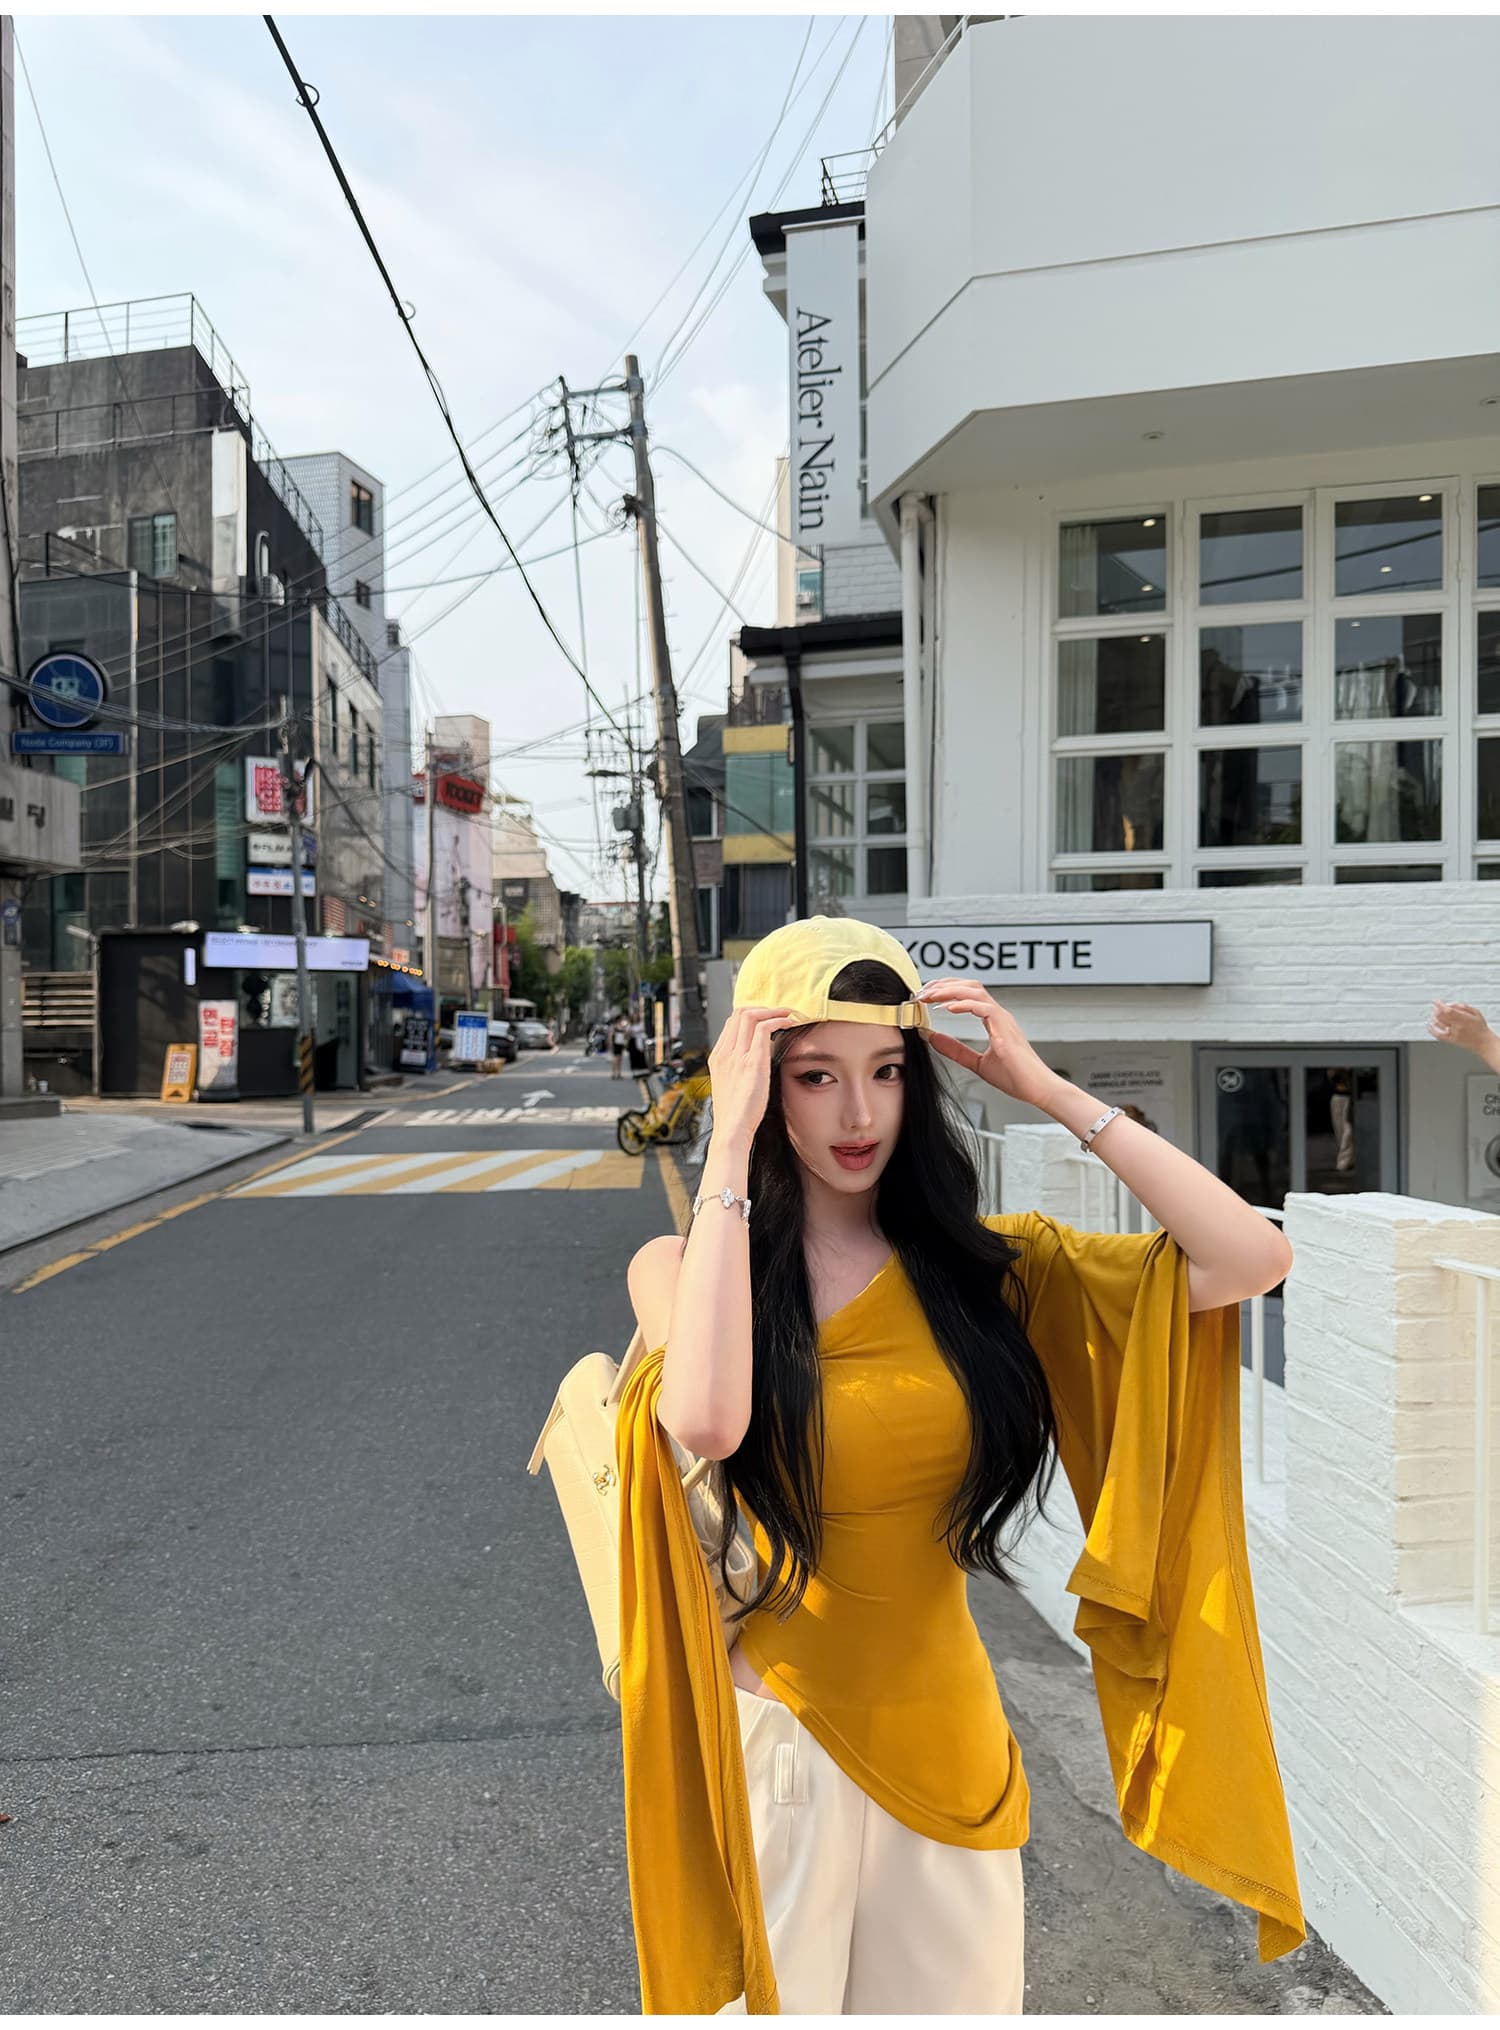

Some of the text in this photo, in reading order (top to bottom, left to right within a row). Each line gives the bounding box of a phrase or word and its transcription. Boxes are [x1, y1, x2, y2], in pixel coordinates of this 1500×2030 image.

[796, 306, 843, 532] Atelier Nain
[48, 737, 91, 749] Company
